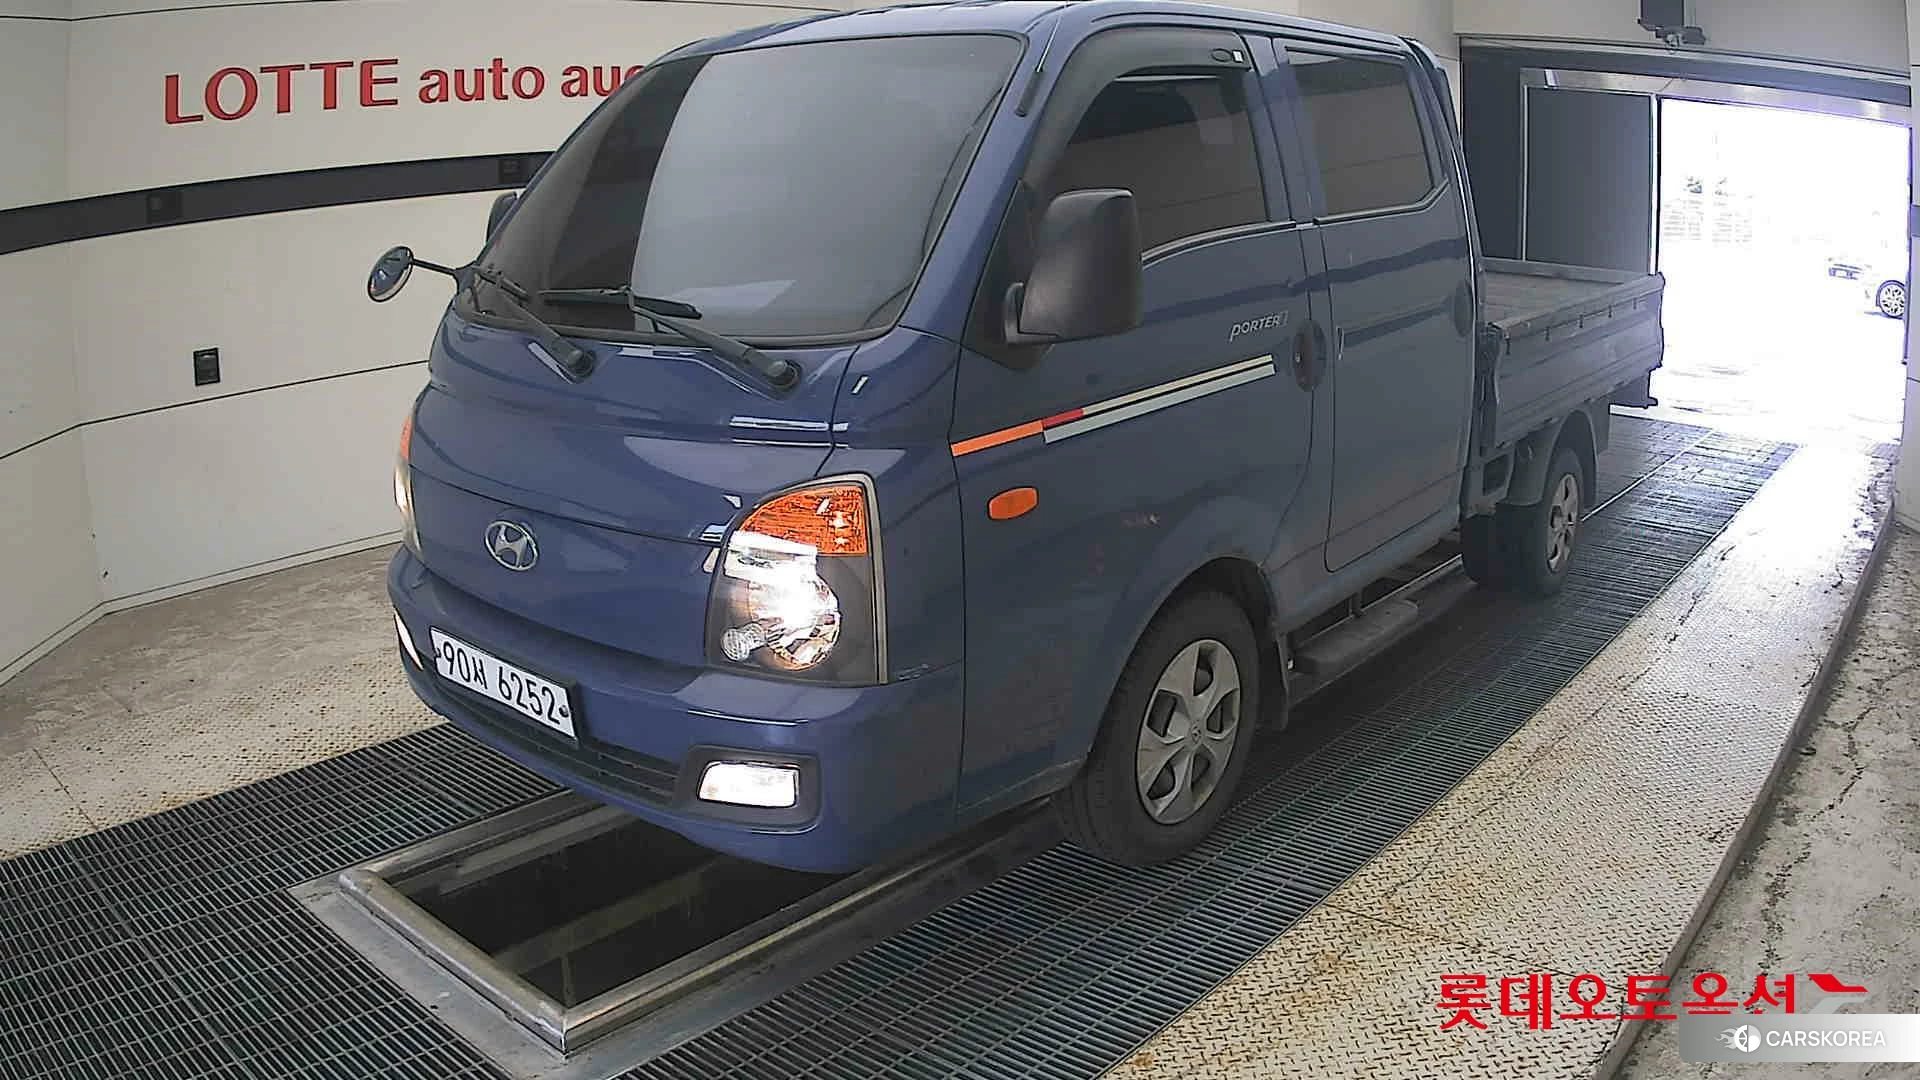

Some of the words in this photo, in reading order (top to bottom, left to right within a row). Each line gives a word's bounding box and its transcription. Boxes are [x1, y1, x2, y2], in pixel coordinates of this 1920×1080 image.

[164, 58, 399, 125] LOTTE
[418, 57, 546, 103] auto
[443, 641, 488, 690] 90서
[499, 666, 561, 725] 6252
